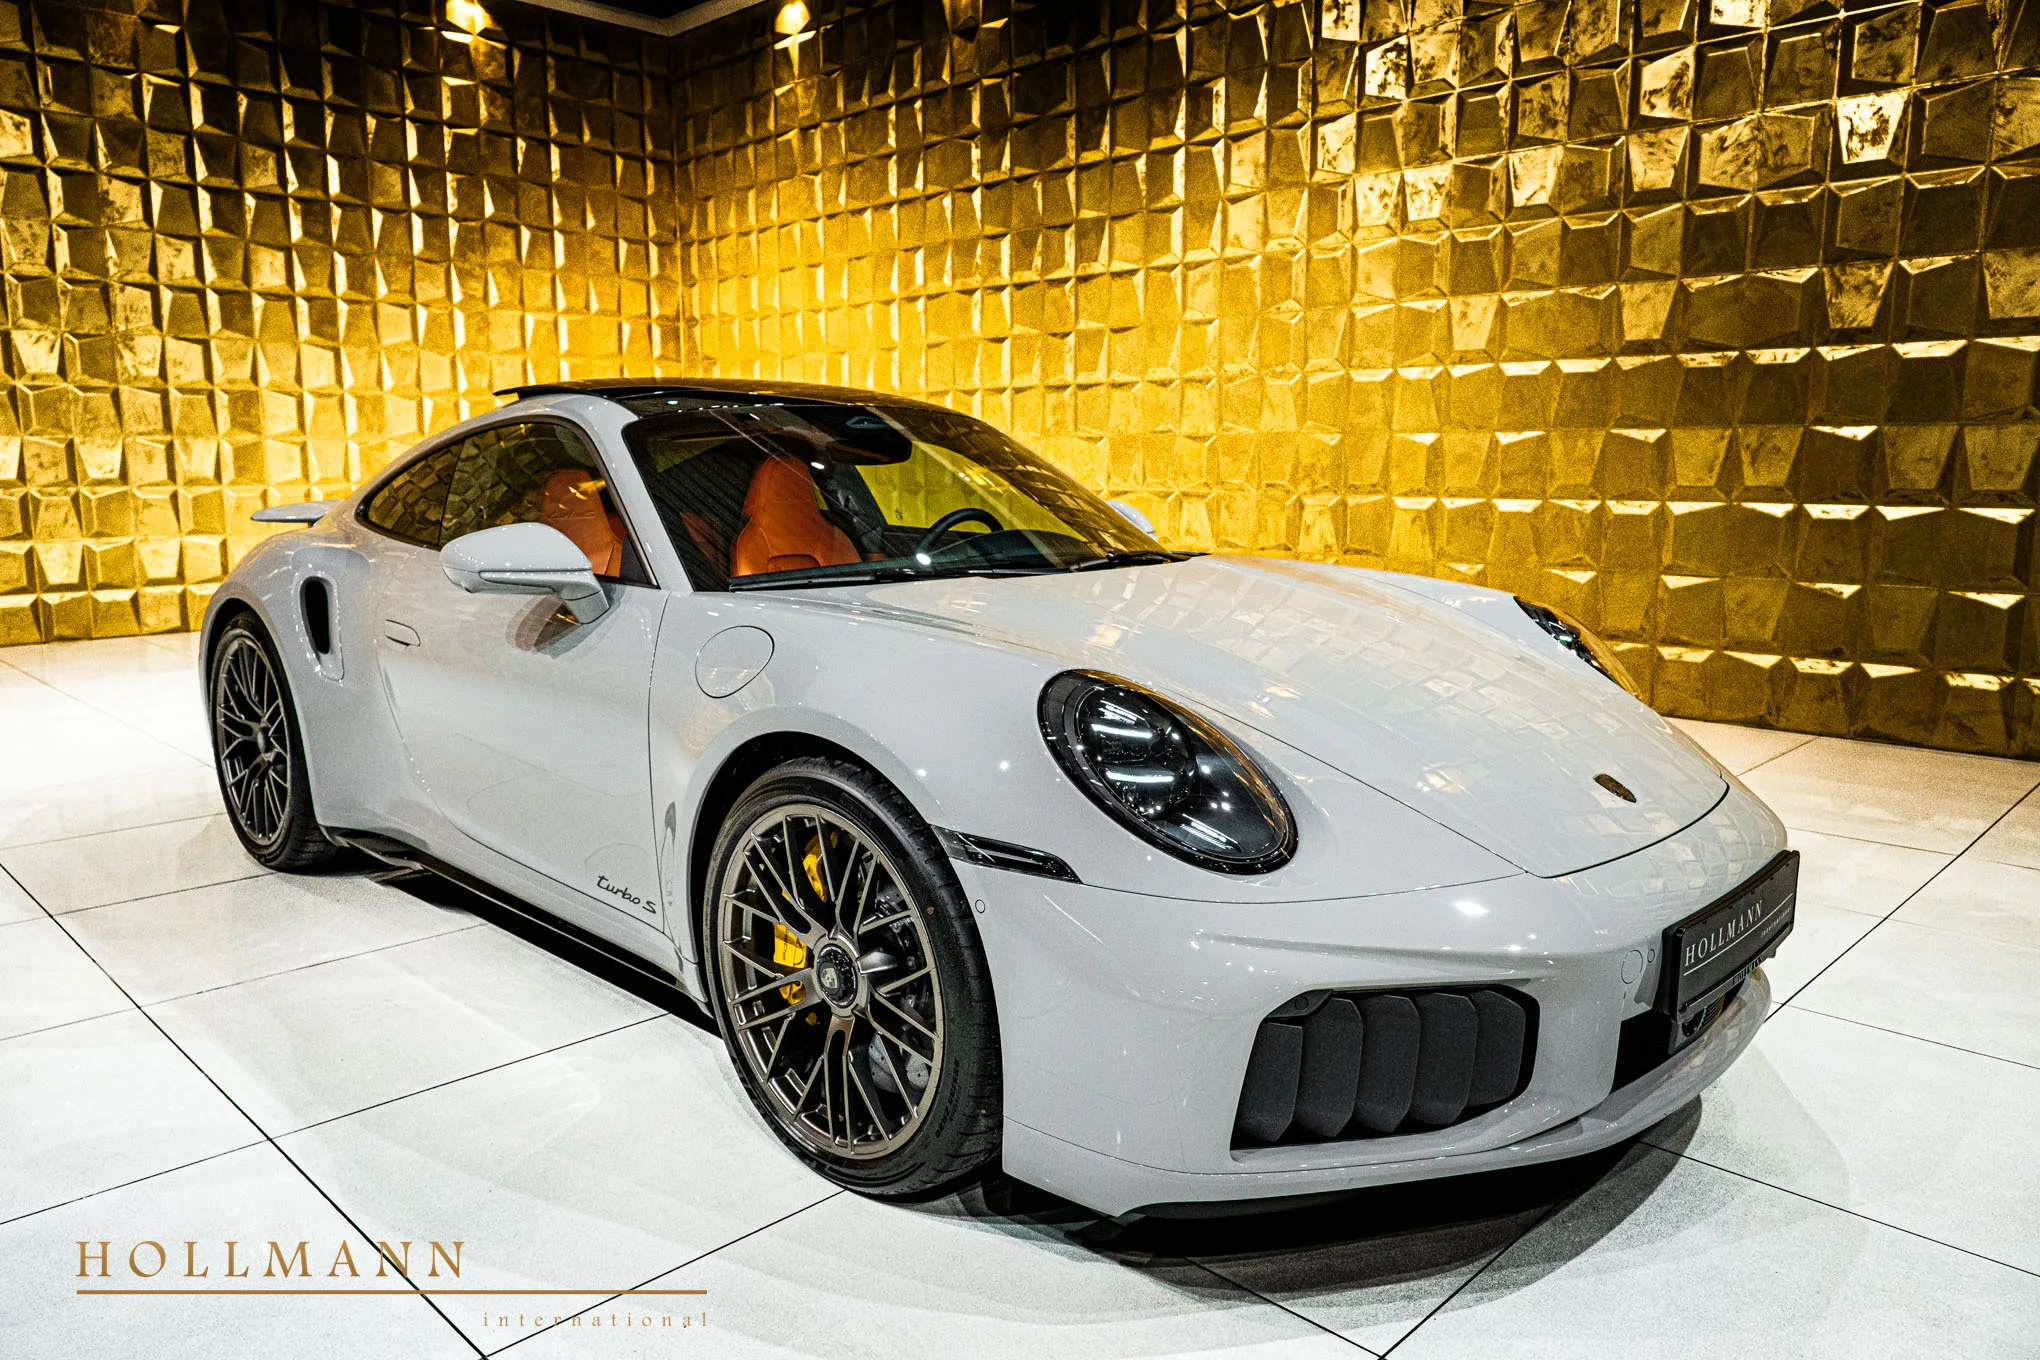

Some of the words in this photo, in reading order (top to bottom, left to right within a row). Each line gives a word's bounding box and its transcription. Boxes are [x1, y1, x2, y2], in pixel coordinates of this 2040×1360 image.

[597, 875, 641, 904] turbo
[642, 900, 657, 914] S
[1684, 900, 1763, 967] HOLLMANN
